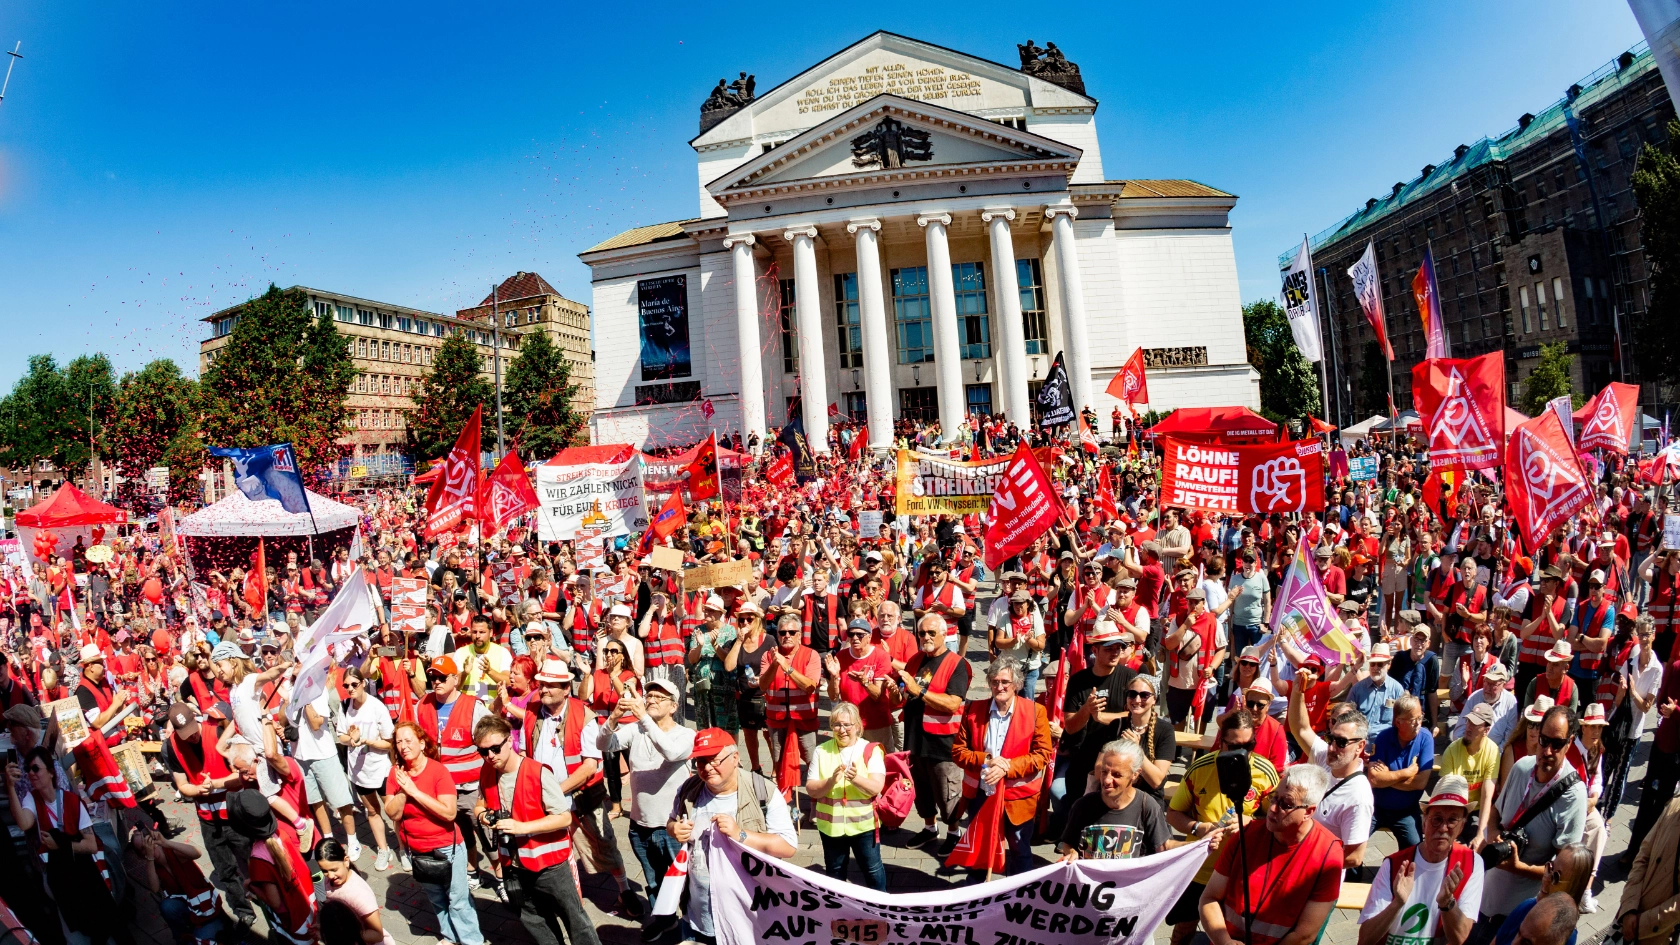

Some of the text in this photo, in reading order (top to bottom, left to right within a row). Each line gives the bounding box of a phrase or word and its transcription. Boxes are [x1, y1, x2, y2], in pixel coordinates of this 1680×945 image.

[829, 76, 856, 86] SEINEN
[858, 74, 884, 83] TIEFEN
[887, 71, 913, 79] SEINEN
[882, 64, 905, 72] ALLEN
[797, 97, 820, 107] WENN
[823, 95, 834, 103] DU
[837, 93, 851, 102] DAS
[907, 85, 922, 93] DER
[924, 83, 944, 91] WELT
[946, 80, 981, 89] GESEHEN
[806, 88, 825, 97] ROLL
[827, 86, 840, 94] ICH
[843, 83, 858, 92] DAS
[861, 81, 884, 90] LEBEN
[917, 75, 947, 84] DEINEM
[949, 73, 971, 82] BLICK
[923, 91, 949, 100] SELBST
[799, 106, 809, 114] SO
[842, 100, 854, 109] DU
[1177, 445, 1240, 466] LÖHNE
[639, 465, 667, 475] MENS
[1175, 463, 1239, 485] RAUF!
[546, 476, 638, 498] WIR ZAHLEN NICHT
[1174, 481, 1238, 494] UMVERTEILEN
[552, 503, 574, 517] FÜR
[576, 501, 603, 513] EURE
[605, 495, 640, 512] KRIEGE
[906, 499, 926, 511] Ford,
[928, 499, 942, 511] VW,
[943, 497, 979, 511] Thyssen:
[1173, 489, 1238, 510] JETZT!
[750, 885, 843, 912] MUSS
[1004, 901, 1139, 938] WERDEN
[836, 923, 880, 943] 915
[919, 923, 982, 945] MTL
